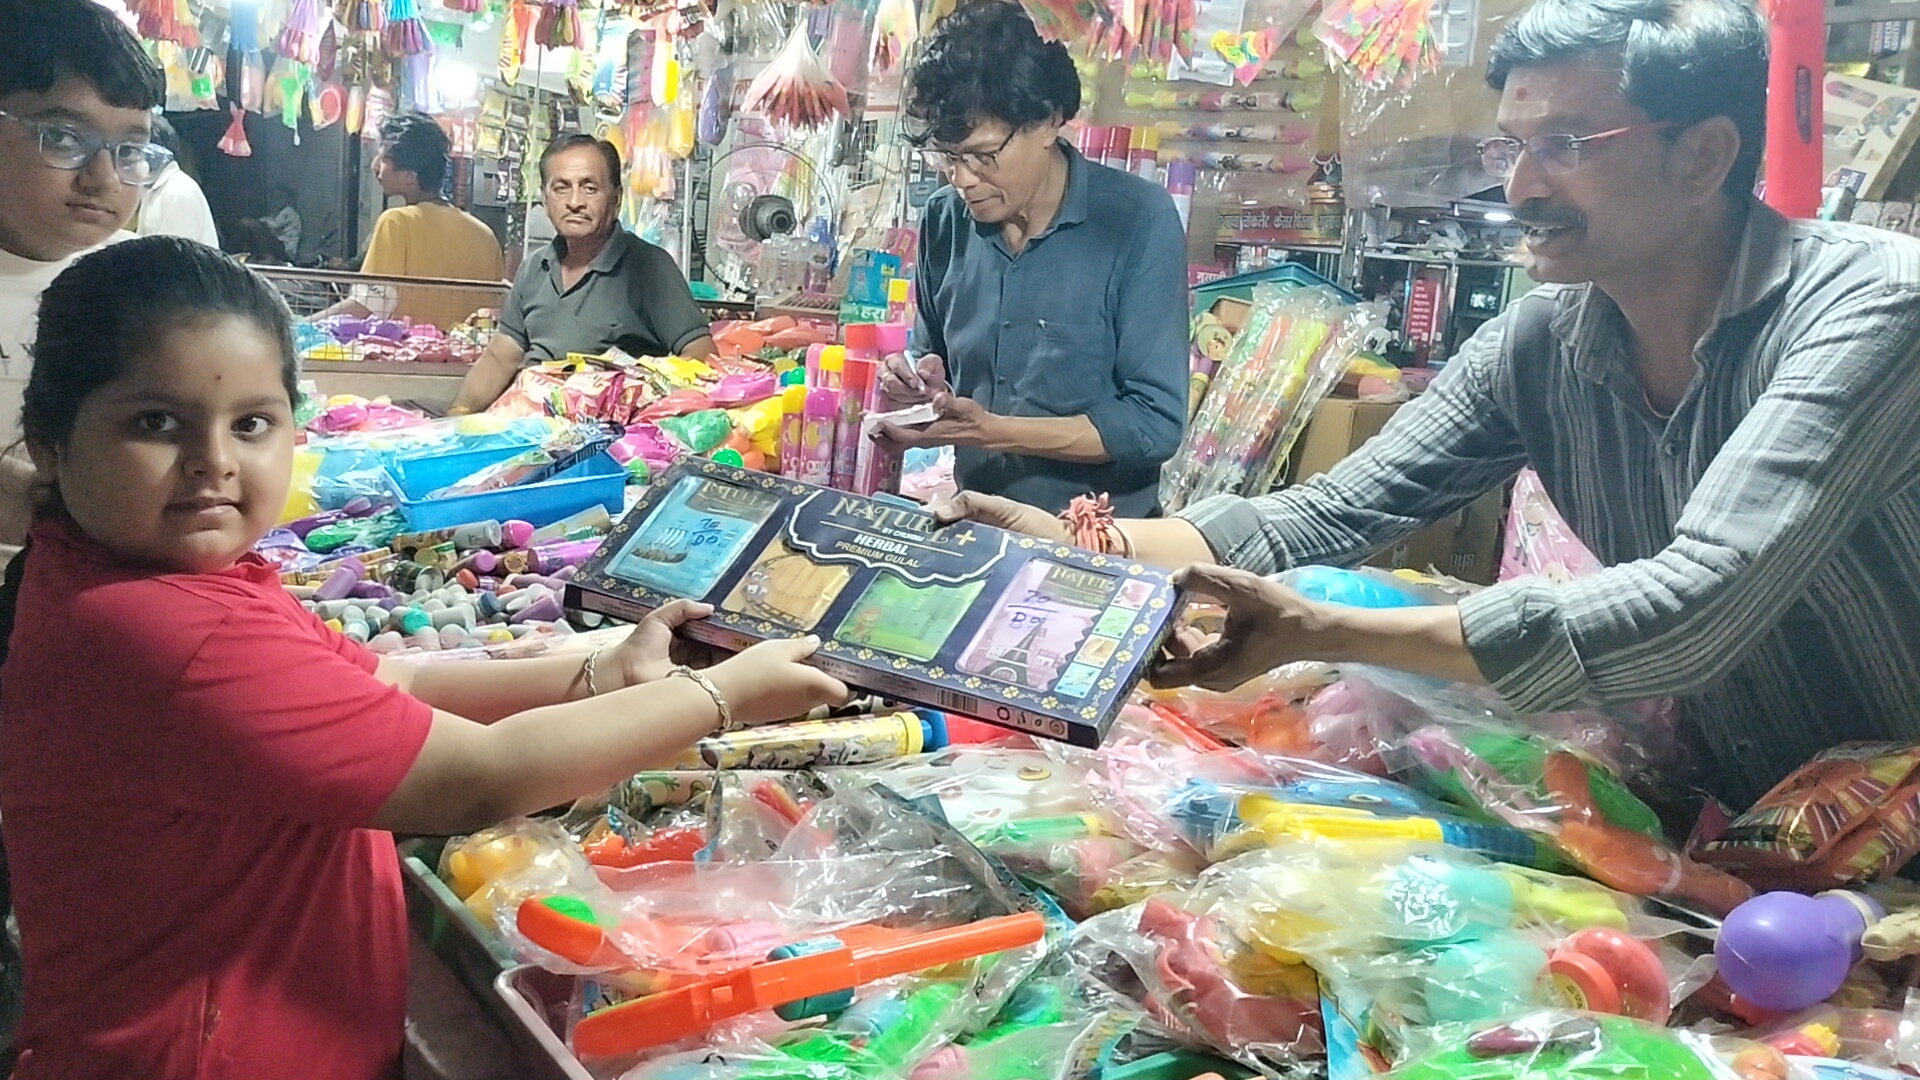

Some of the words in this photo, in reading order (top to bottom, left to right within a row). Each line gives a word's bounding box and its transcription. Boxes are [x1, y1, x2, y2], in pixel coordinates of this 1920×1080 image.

[835, 541, 885, 560] PREMIUM
[885, 554, 919, 568] GULAL
[854, 534, 909, 555] HERBAL
